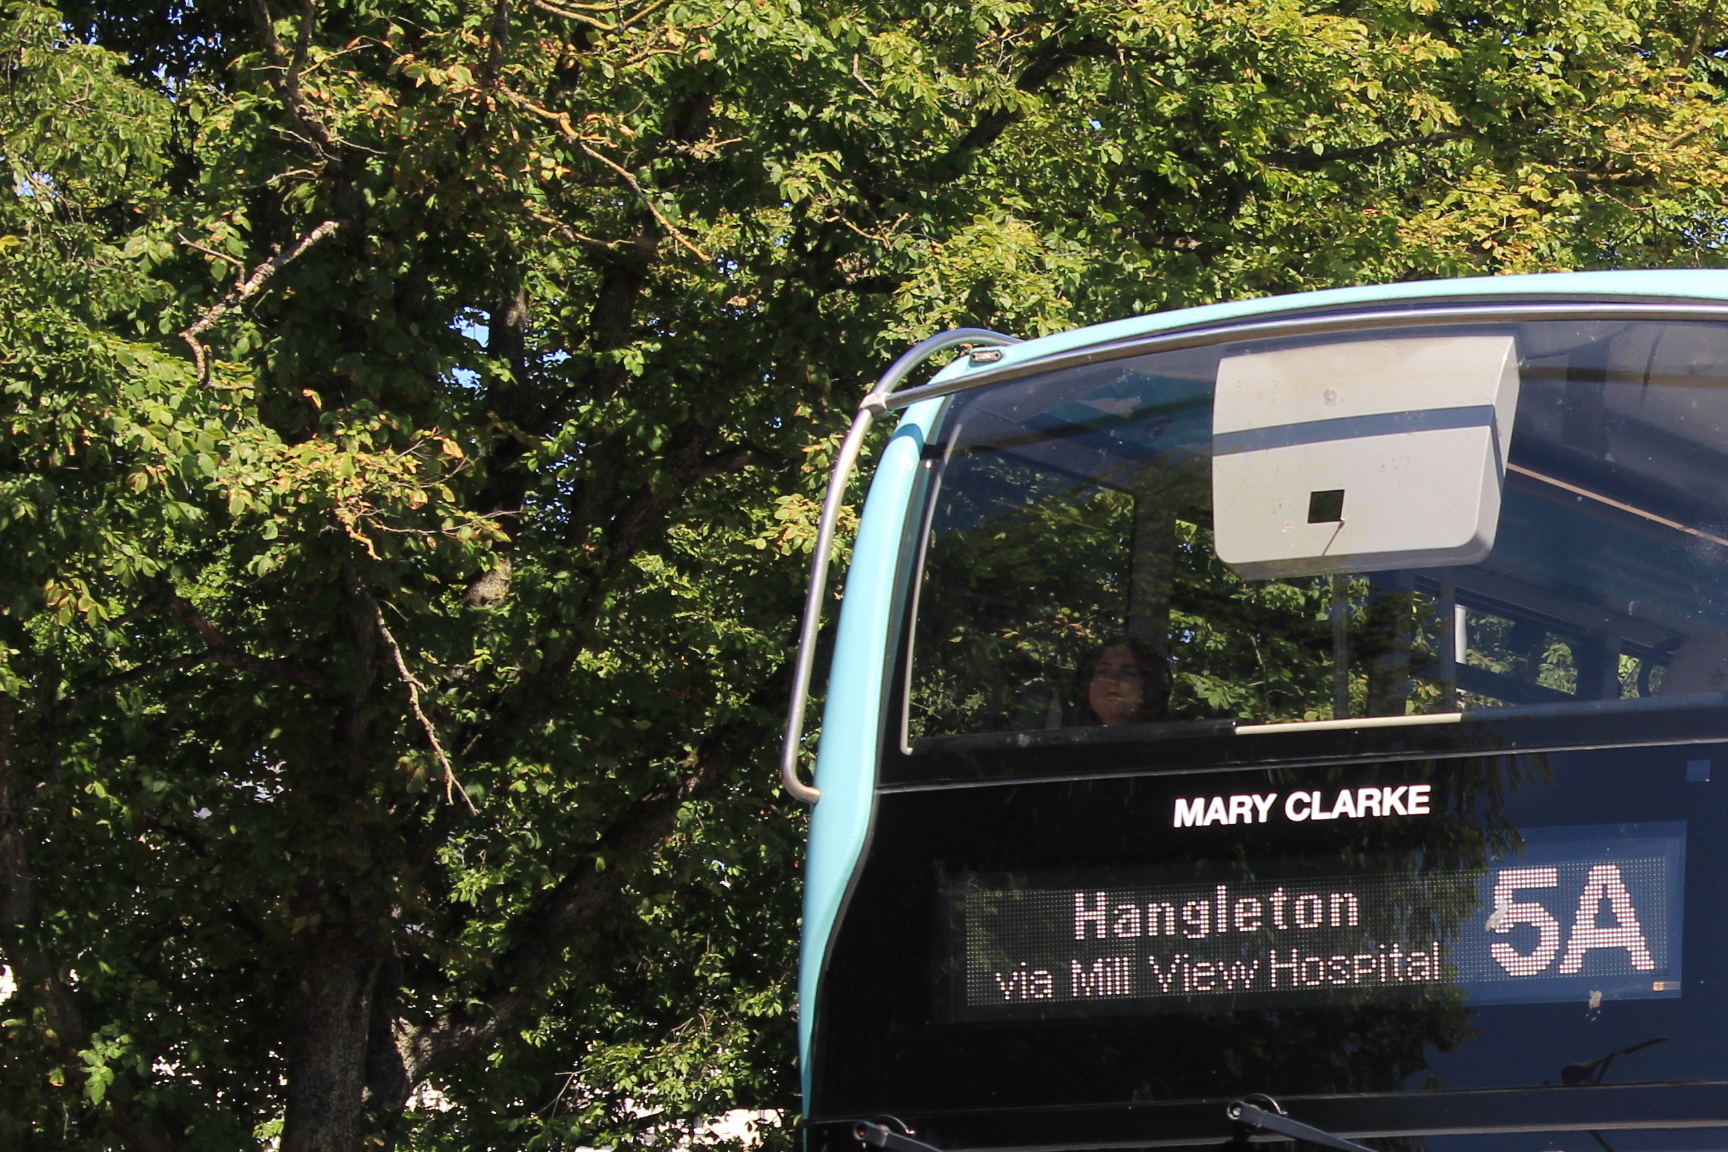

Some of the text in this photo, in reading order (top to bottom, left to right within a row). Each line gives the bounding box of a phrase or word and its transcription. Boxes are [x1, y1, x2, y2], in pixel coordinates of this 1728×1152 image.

[1173, 785, 1431, 828] MARY CLARKE
[1073, 884, 1360, 941] Hangleton
[1489, 864, 1656, 978] 5A
[996, 942, 1441, 1001] via Mill View Hospital
